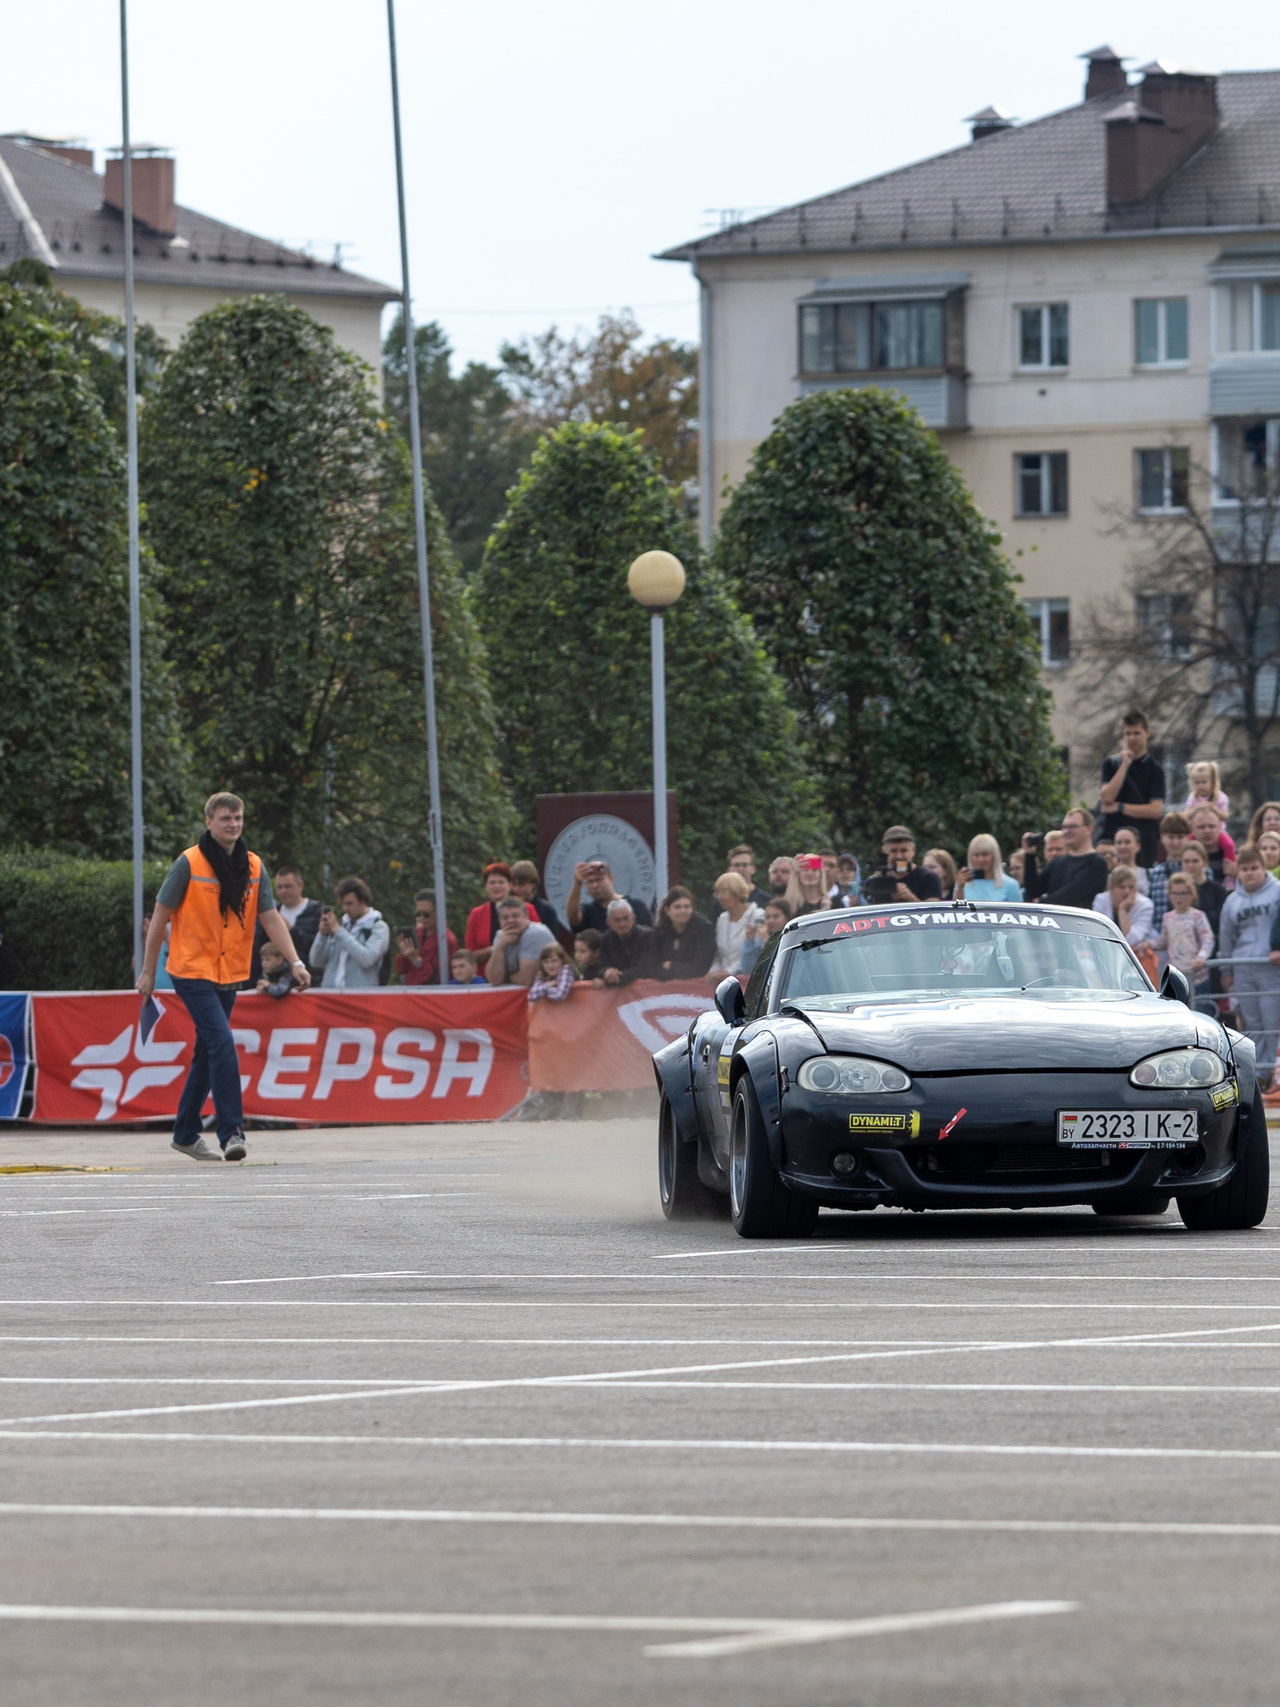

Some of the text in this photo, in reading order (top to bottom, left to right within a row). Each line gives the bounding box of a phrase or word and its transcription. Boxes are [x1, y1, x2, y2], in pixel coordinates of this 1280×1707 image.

[1237, 903, 1271, 922] ARMY
[832, 912, 1061, 936] ADTGYMKHANA
[1062, 1128, 1075, 1139] BY
[1081, 1114, 1135, 1139] 2323
